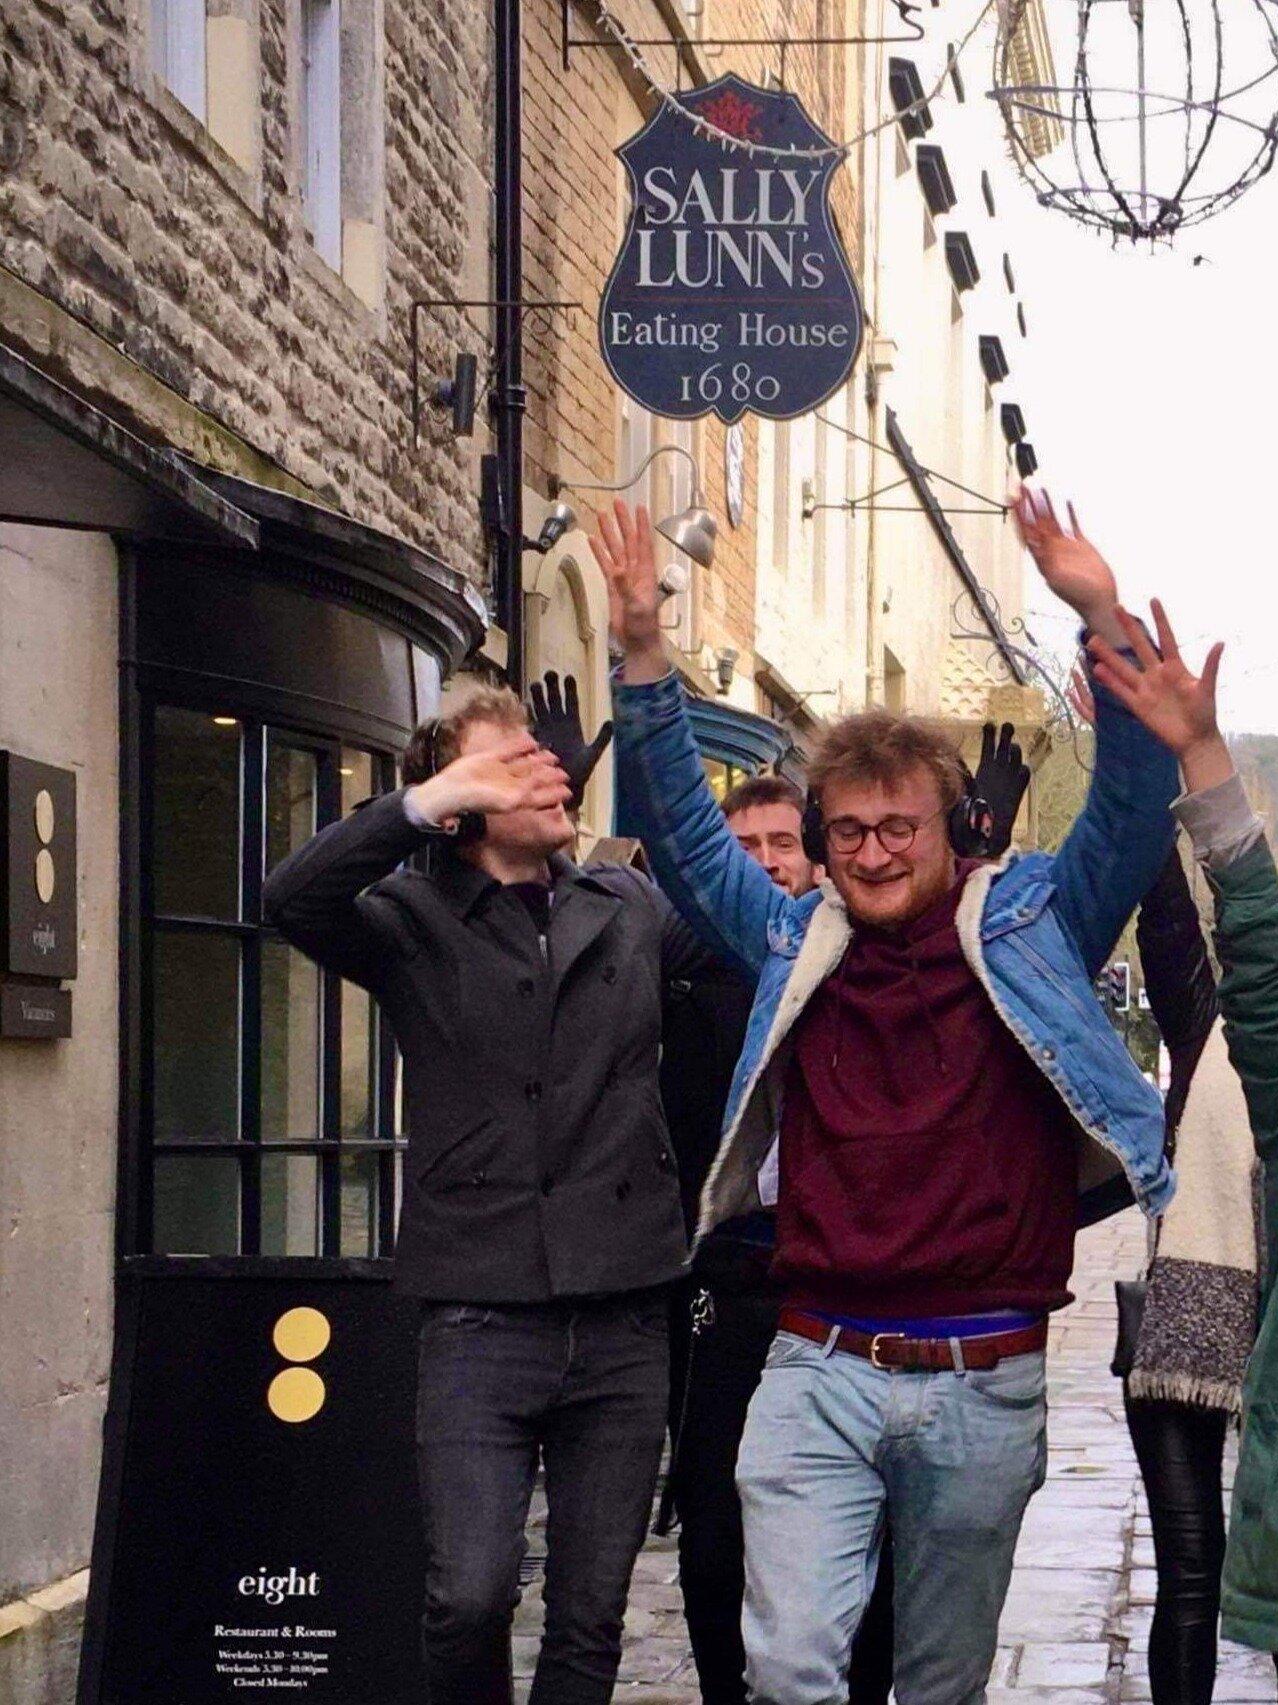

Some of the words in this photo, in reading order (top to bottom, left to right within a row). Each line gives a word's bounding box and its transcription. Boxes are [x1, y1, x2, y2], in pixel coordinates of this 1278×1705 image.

[644, 167, 823, 226] SALLY
[636, 229, 825, 289] LUNN's
[610, 312, 722, 353] Eating
[739, 313, 849, 347] House
[680, 362, 781, 401] 1680
[238, 1566, 320, 1605] eight
[214, 1625, 279, 1637] Restaurant
[281, 1626, 292, 1637] &
[295, 1626, 337, 1638] Rooms
[233, 1677, 265, 1687] Closed
[266, 1678, 308, 1689] Mondays
